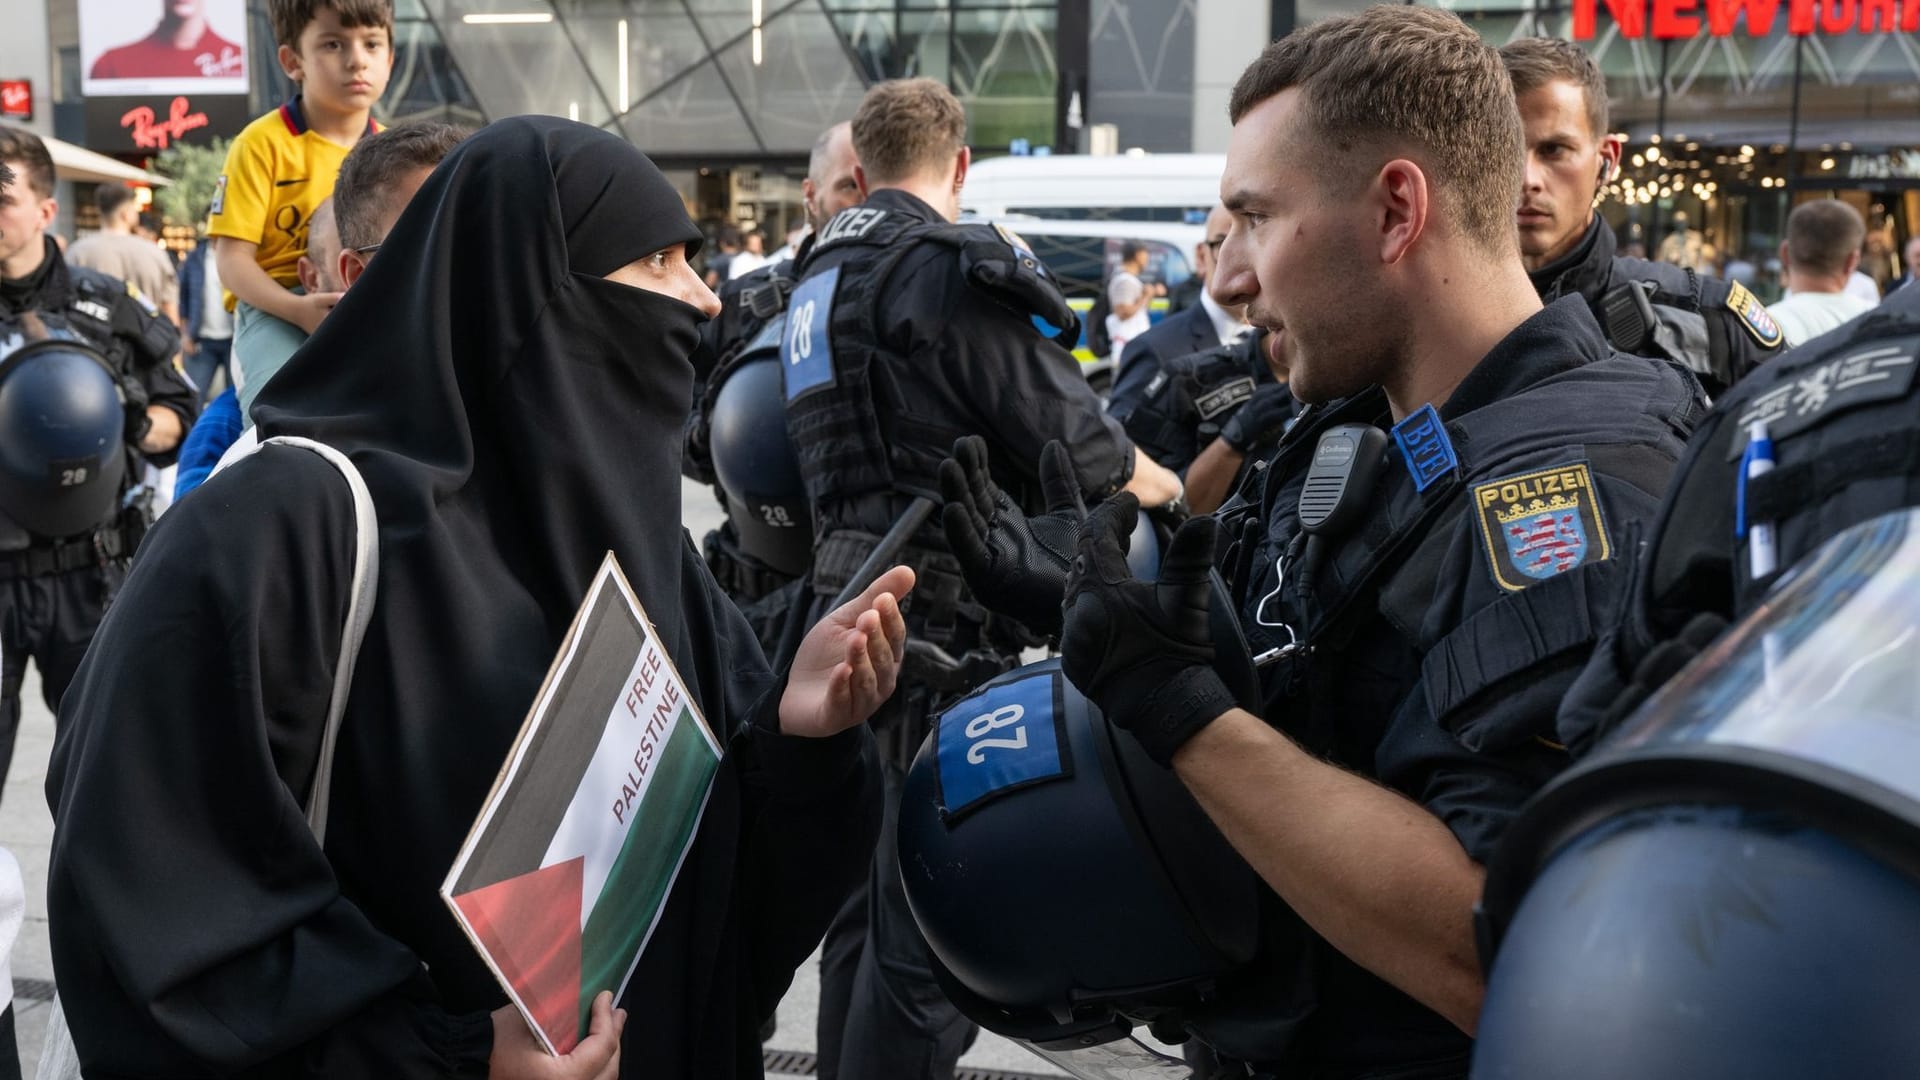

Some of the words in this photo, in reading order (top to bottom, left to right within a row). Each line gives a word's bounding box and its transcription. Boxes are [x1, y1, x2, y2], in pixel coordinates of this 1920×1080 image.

[121, 97, 208, 148] Ray-Ban
[790, 299, 816, 366] 28
[61, 467, 88, 486] 28
[1480, 471, 1586, 508] POLIZEI
[760, 505, 795, 527] 28
[625, 647, 661, 719] FREE
[612, 679, 680, 825] PALESTINE
[965, 703, 1028, 765] 28
